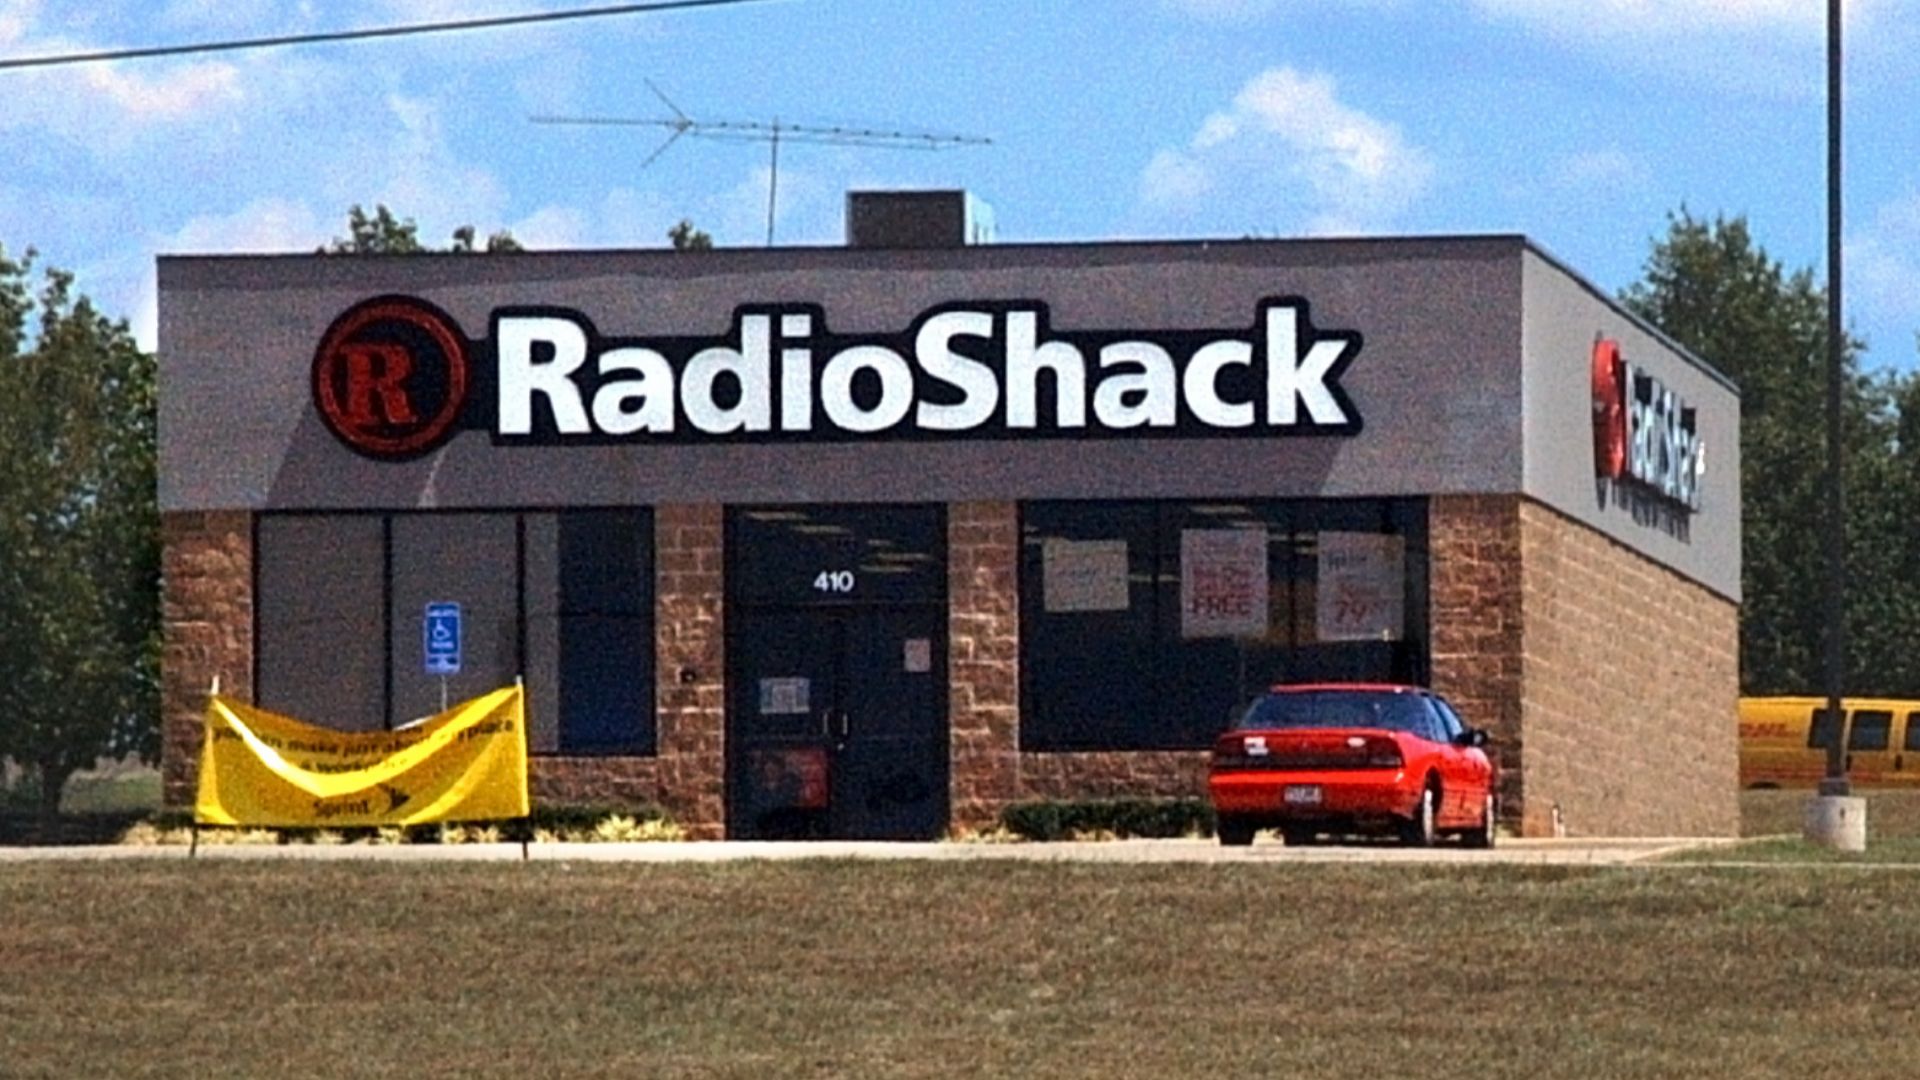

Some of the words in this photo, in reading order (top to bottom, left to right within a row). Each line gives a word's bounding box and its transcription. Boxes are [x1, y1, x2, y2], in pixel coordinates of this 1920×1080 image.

[499, 308, 1349, 434] RadioShack
[814, 571, 854, 592] 410
[313, 798, 369, 818] Sprint
